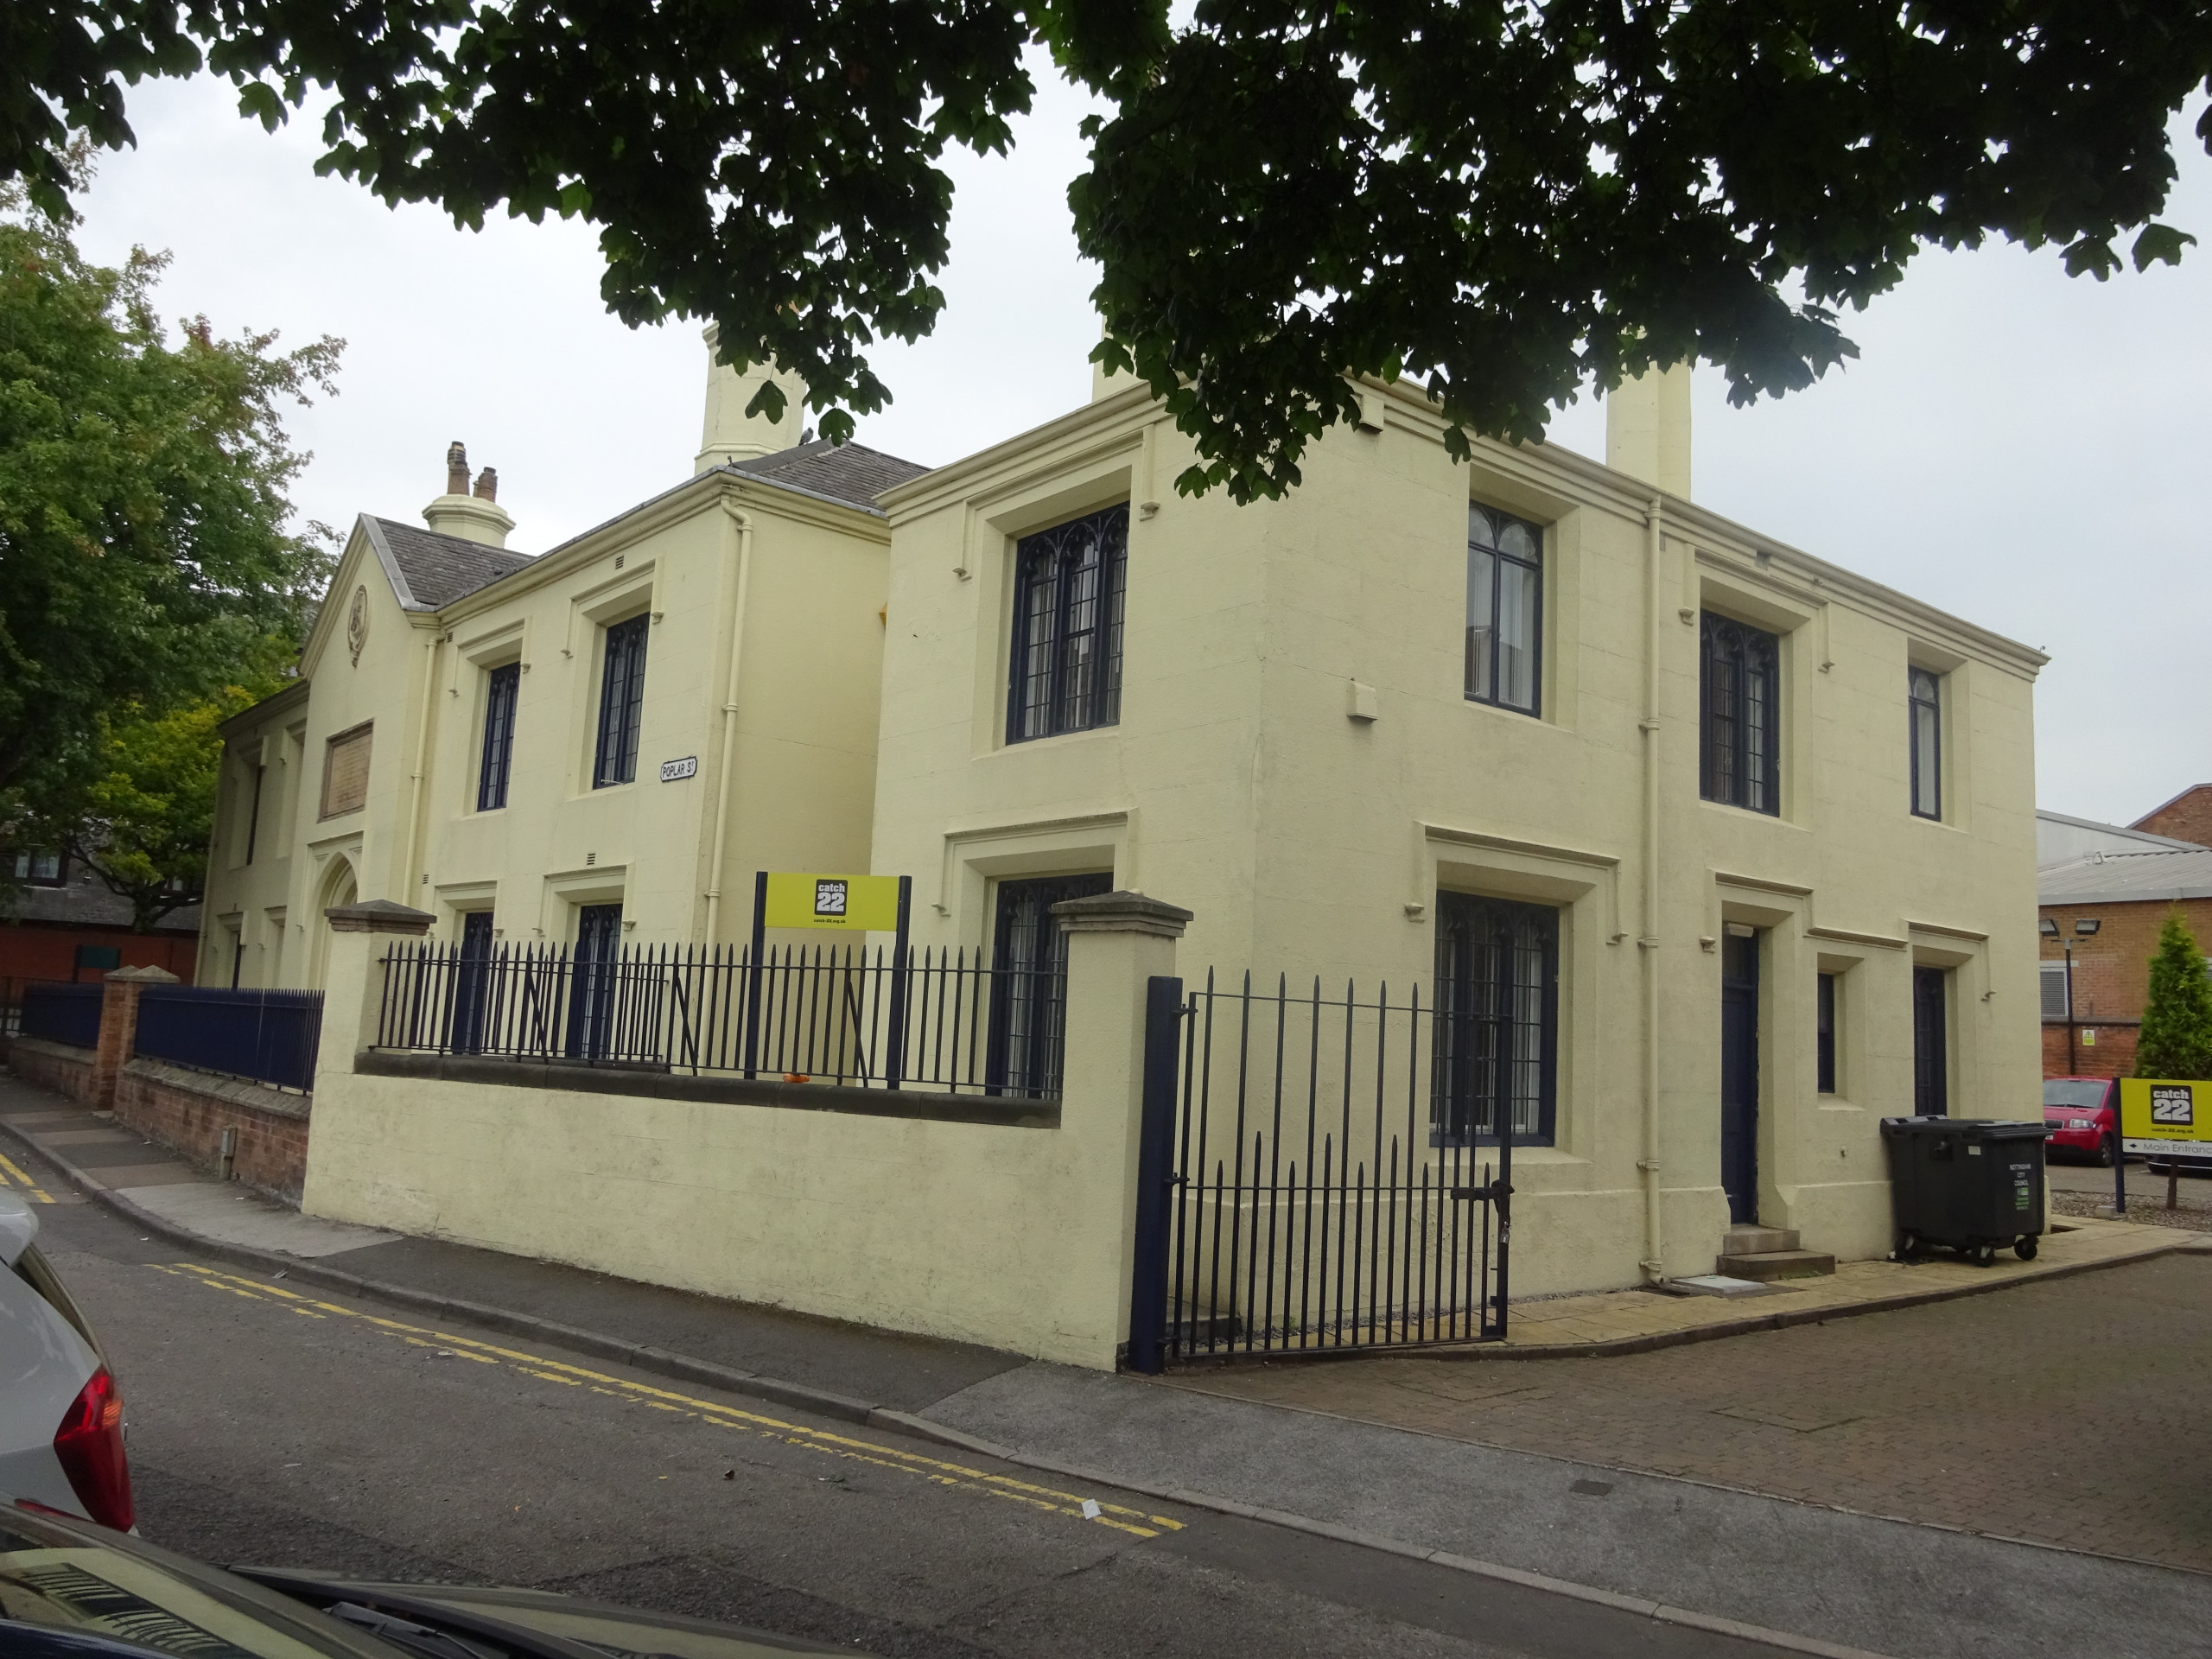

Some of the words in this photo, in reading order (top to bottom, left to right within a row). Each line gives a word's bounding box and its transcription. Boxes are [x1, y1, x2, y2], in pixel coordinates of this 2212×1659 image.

[663, 763, 685, 778] POPLAR
[818, 883, 845, 892] catch
[817, 892, 845, 912] 22
[2153, 1089, 2190, 1099] catch
[2153, 1098, 2190, 1122] 22
[2143, 1143, 2170, 1152] Main
